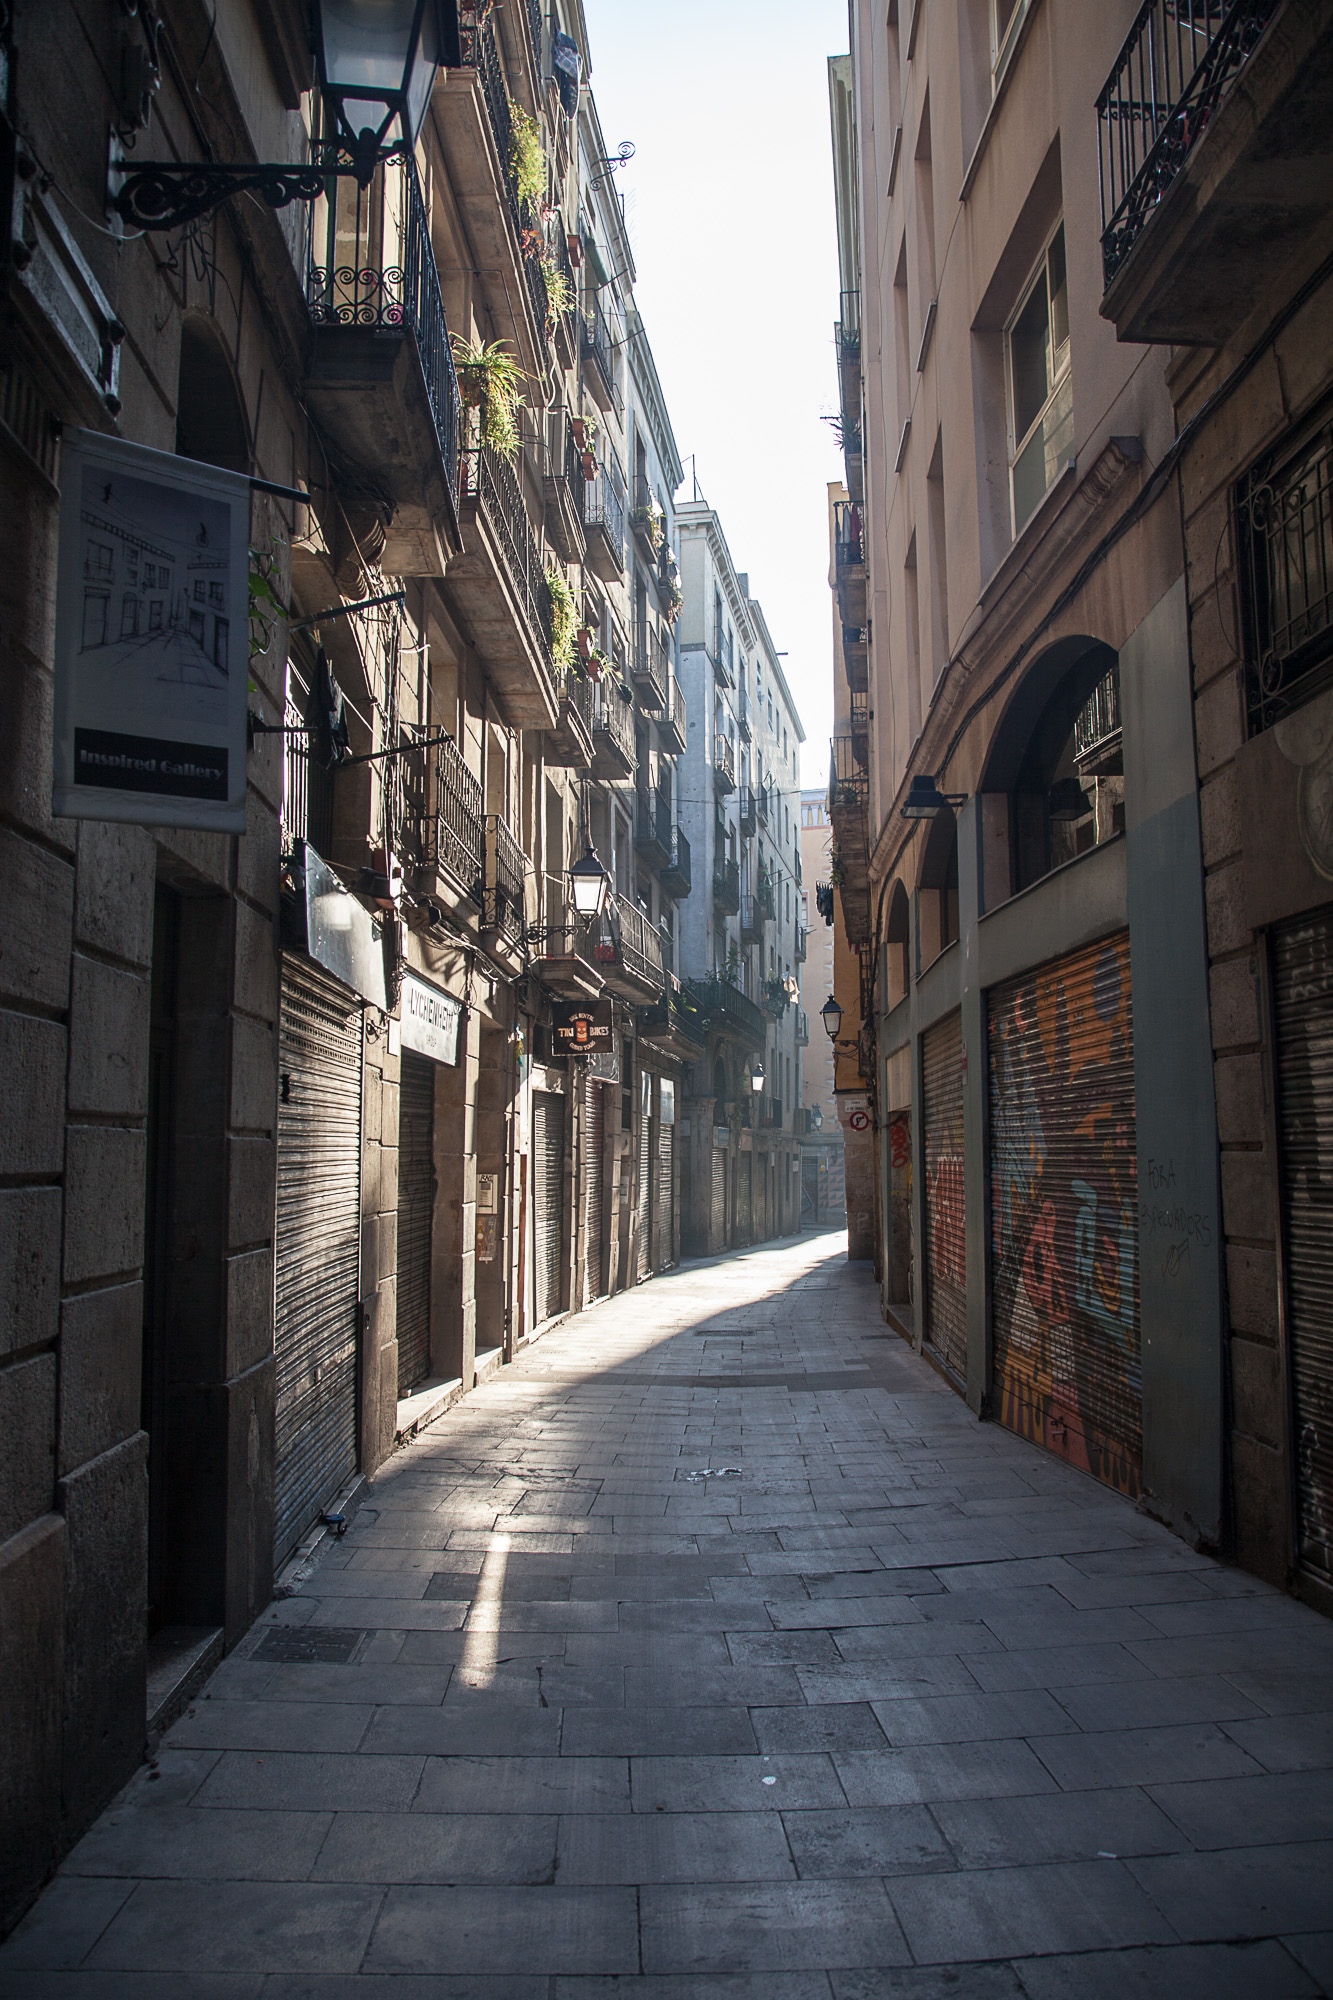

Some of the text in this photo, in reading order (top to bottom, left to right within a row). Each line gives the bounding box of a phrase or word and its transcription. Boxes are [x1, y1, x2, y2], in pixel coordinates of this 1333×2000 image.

[80, 749, 225, 780] Inspired Gallery
[558, 1027, 574, 1038] TIKI
[589, 1026, 609, 1037] BIKES
[1147, 1158, 1176, 1189] FORA
